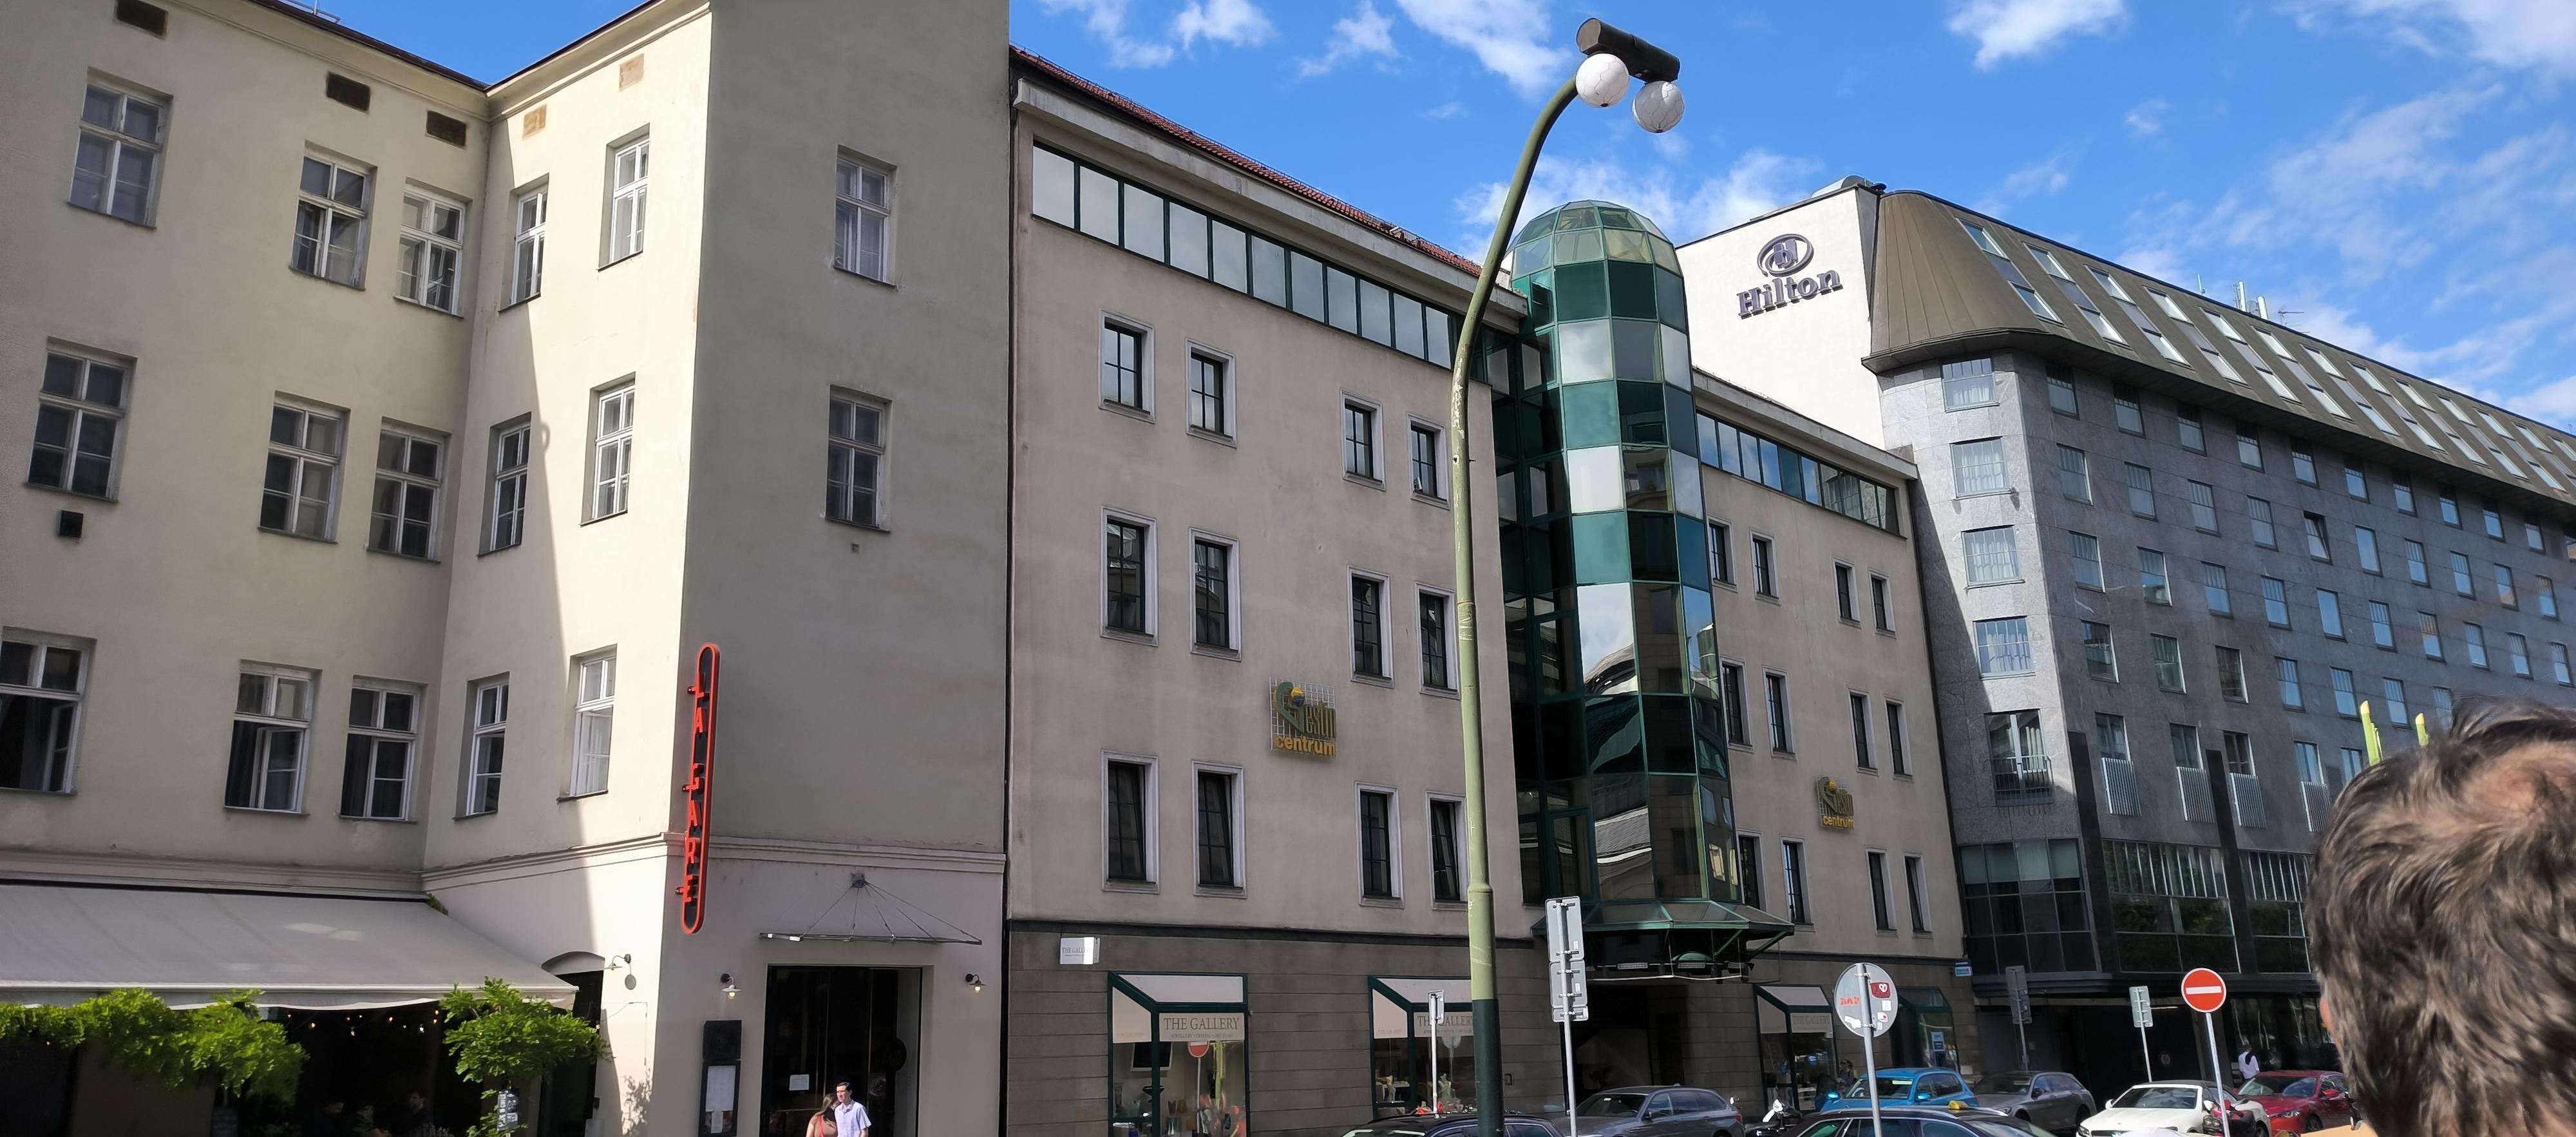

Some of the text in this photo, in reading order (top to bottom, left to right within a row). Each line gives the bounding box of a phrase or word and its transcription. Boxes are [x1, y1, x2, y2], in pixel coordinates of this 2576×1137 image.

[1736, 270, 1843, 320] Hilton
[1274, 734, 1336, 757] centrum
[684, 672, 707, 903] LA GARE
[1823, 815, 1855, 829] centrum
[1164, 1018, 1239, 1030] THE GALLERY
[1417, 1015, 1473, 1027] TH ALLER
